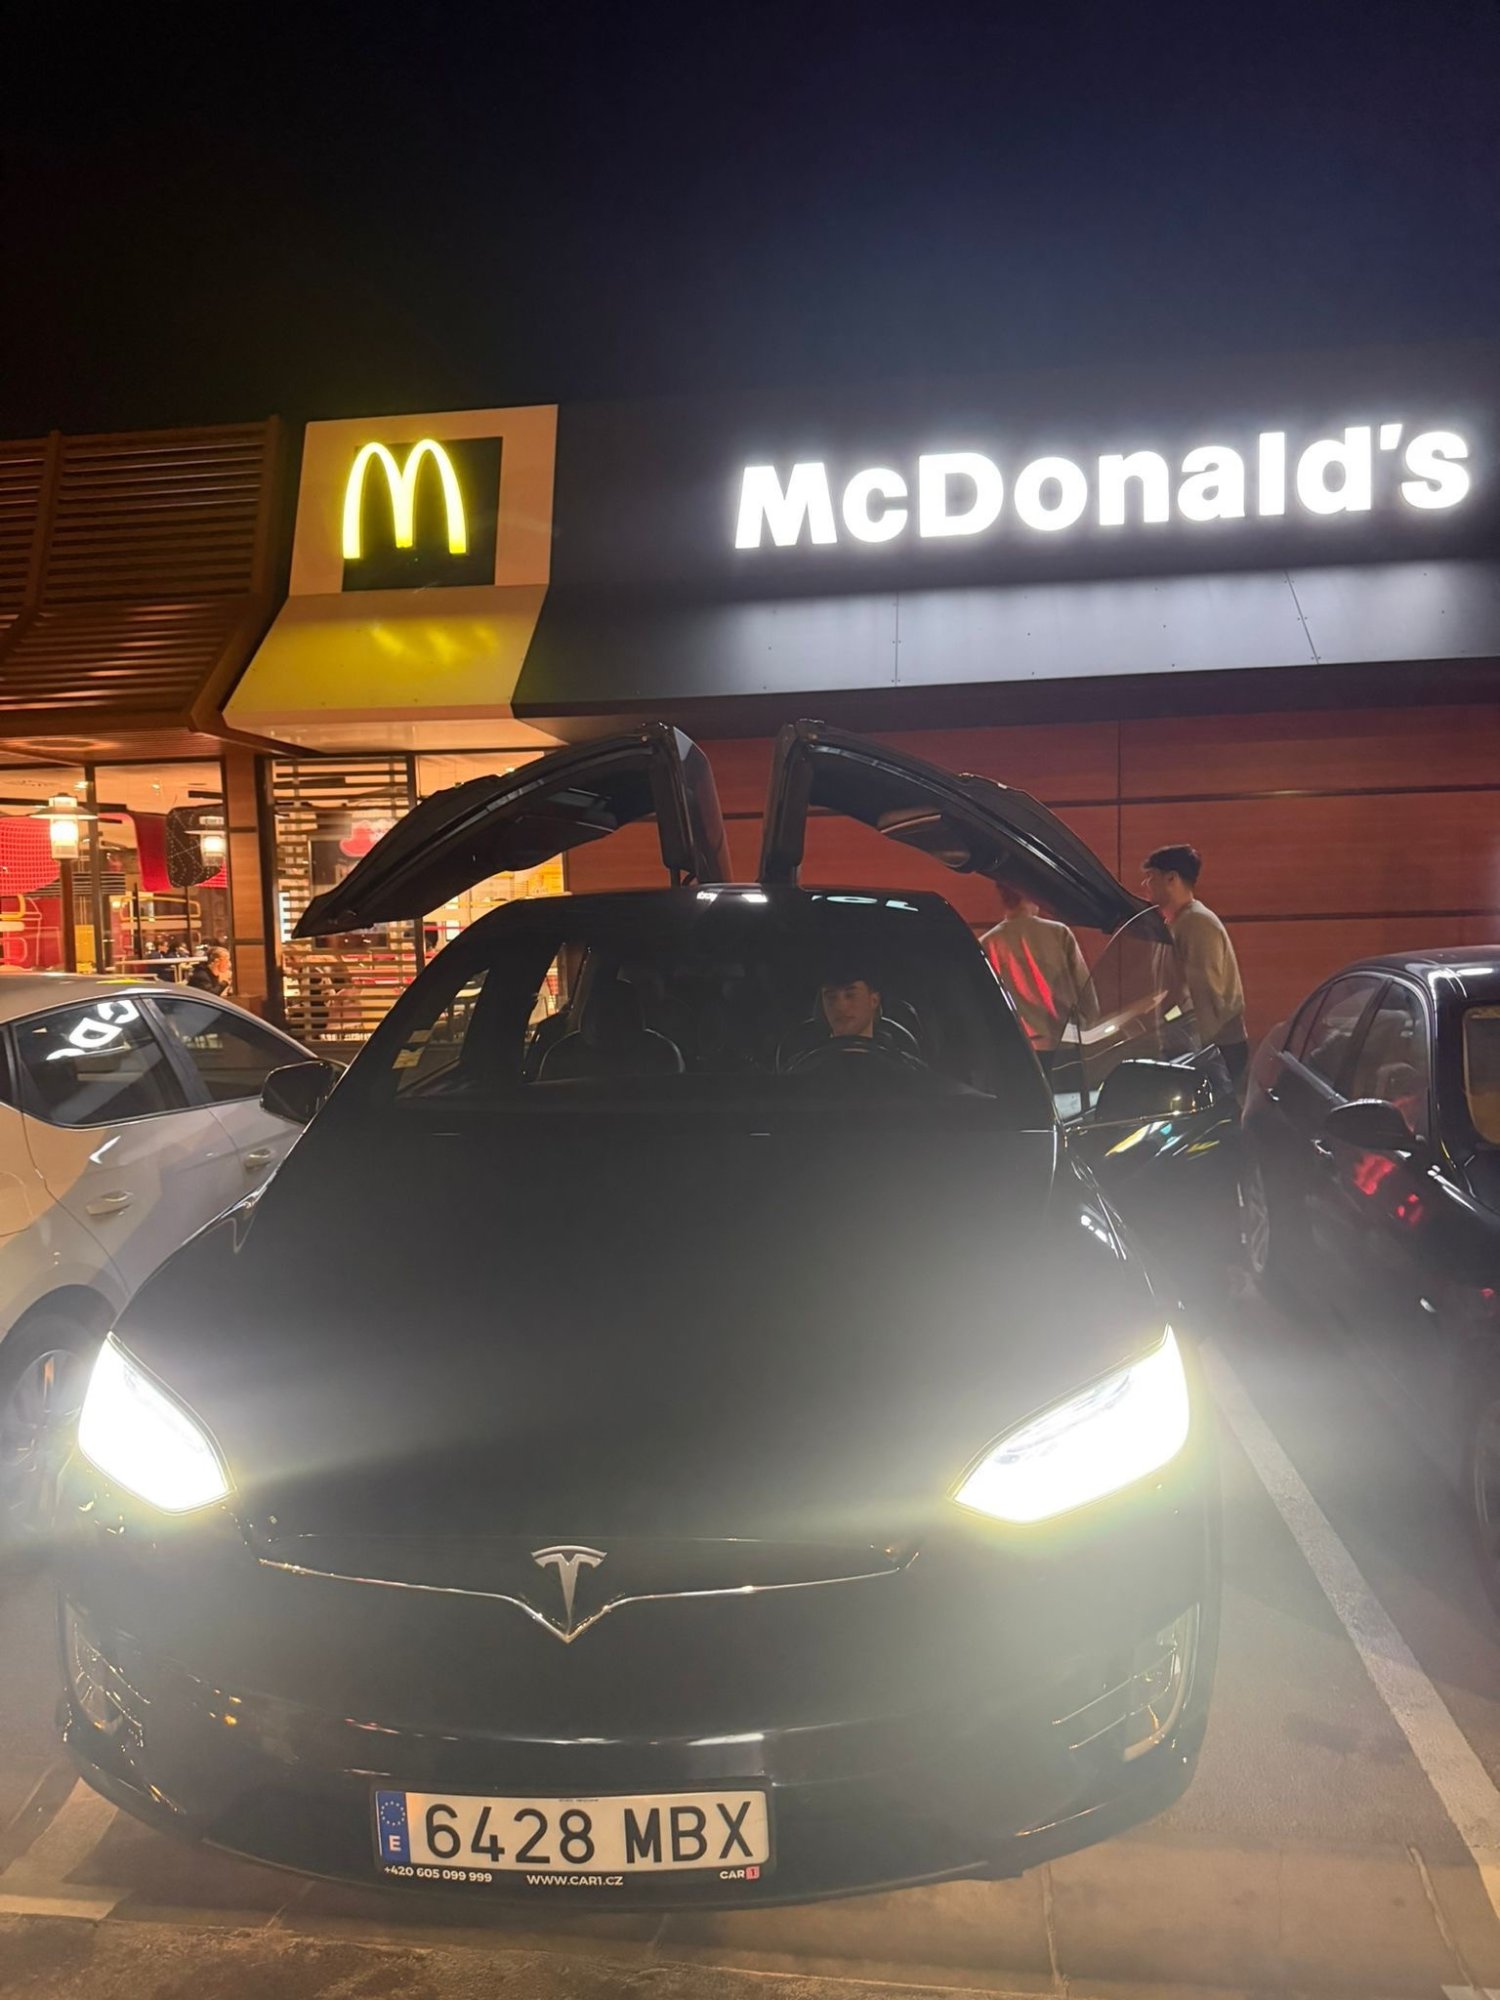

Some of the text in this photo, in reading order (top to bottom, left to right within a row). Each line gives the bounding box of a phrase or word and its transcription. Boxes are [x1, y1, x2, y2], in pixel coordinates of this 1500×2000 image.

[734, 423, 1471, 549] McDonald's
[425, 1801, 753, 1865] 6428 MBX
[389, 1835, 401, 1851] E
[384, 1865, 492, 1883] +420 605 099 999
[526, 1875, 623, 1886] WWW.CAR1.CZ
